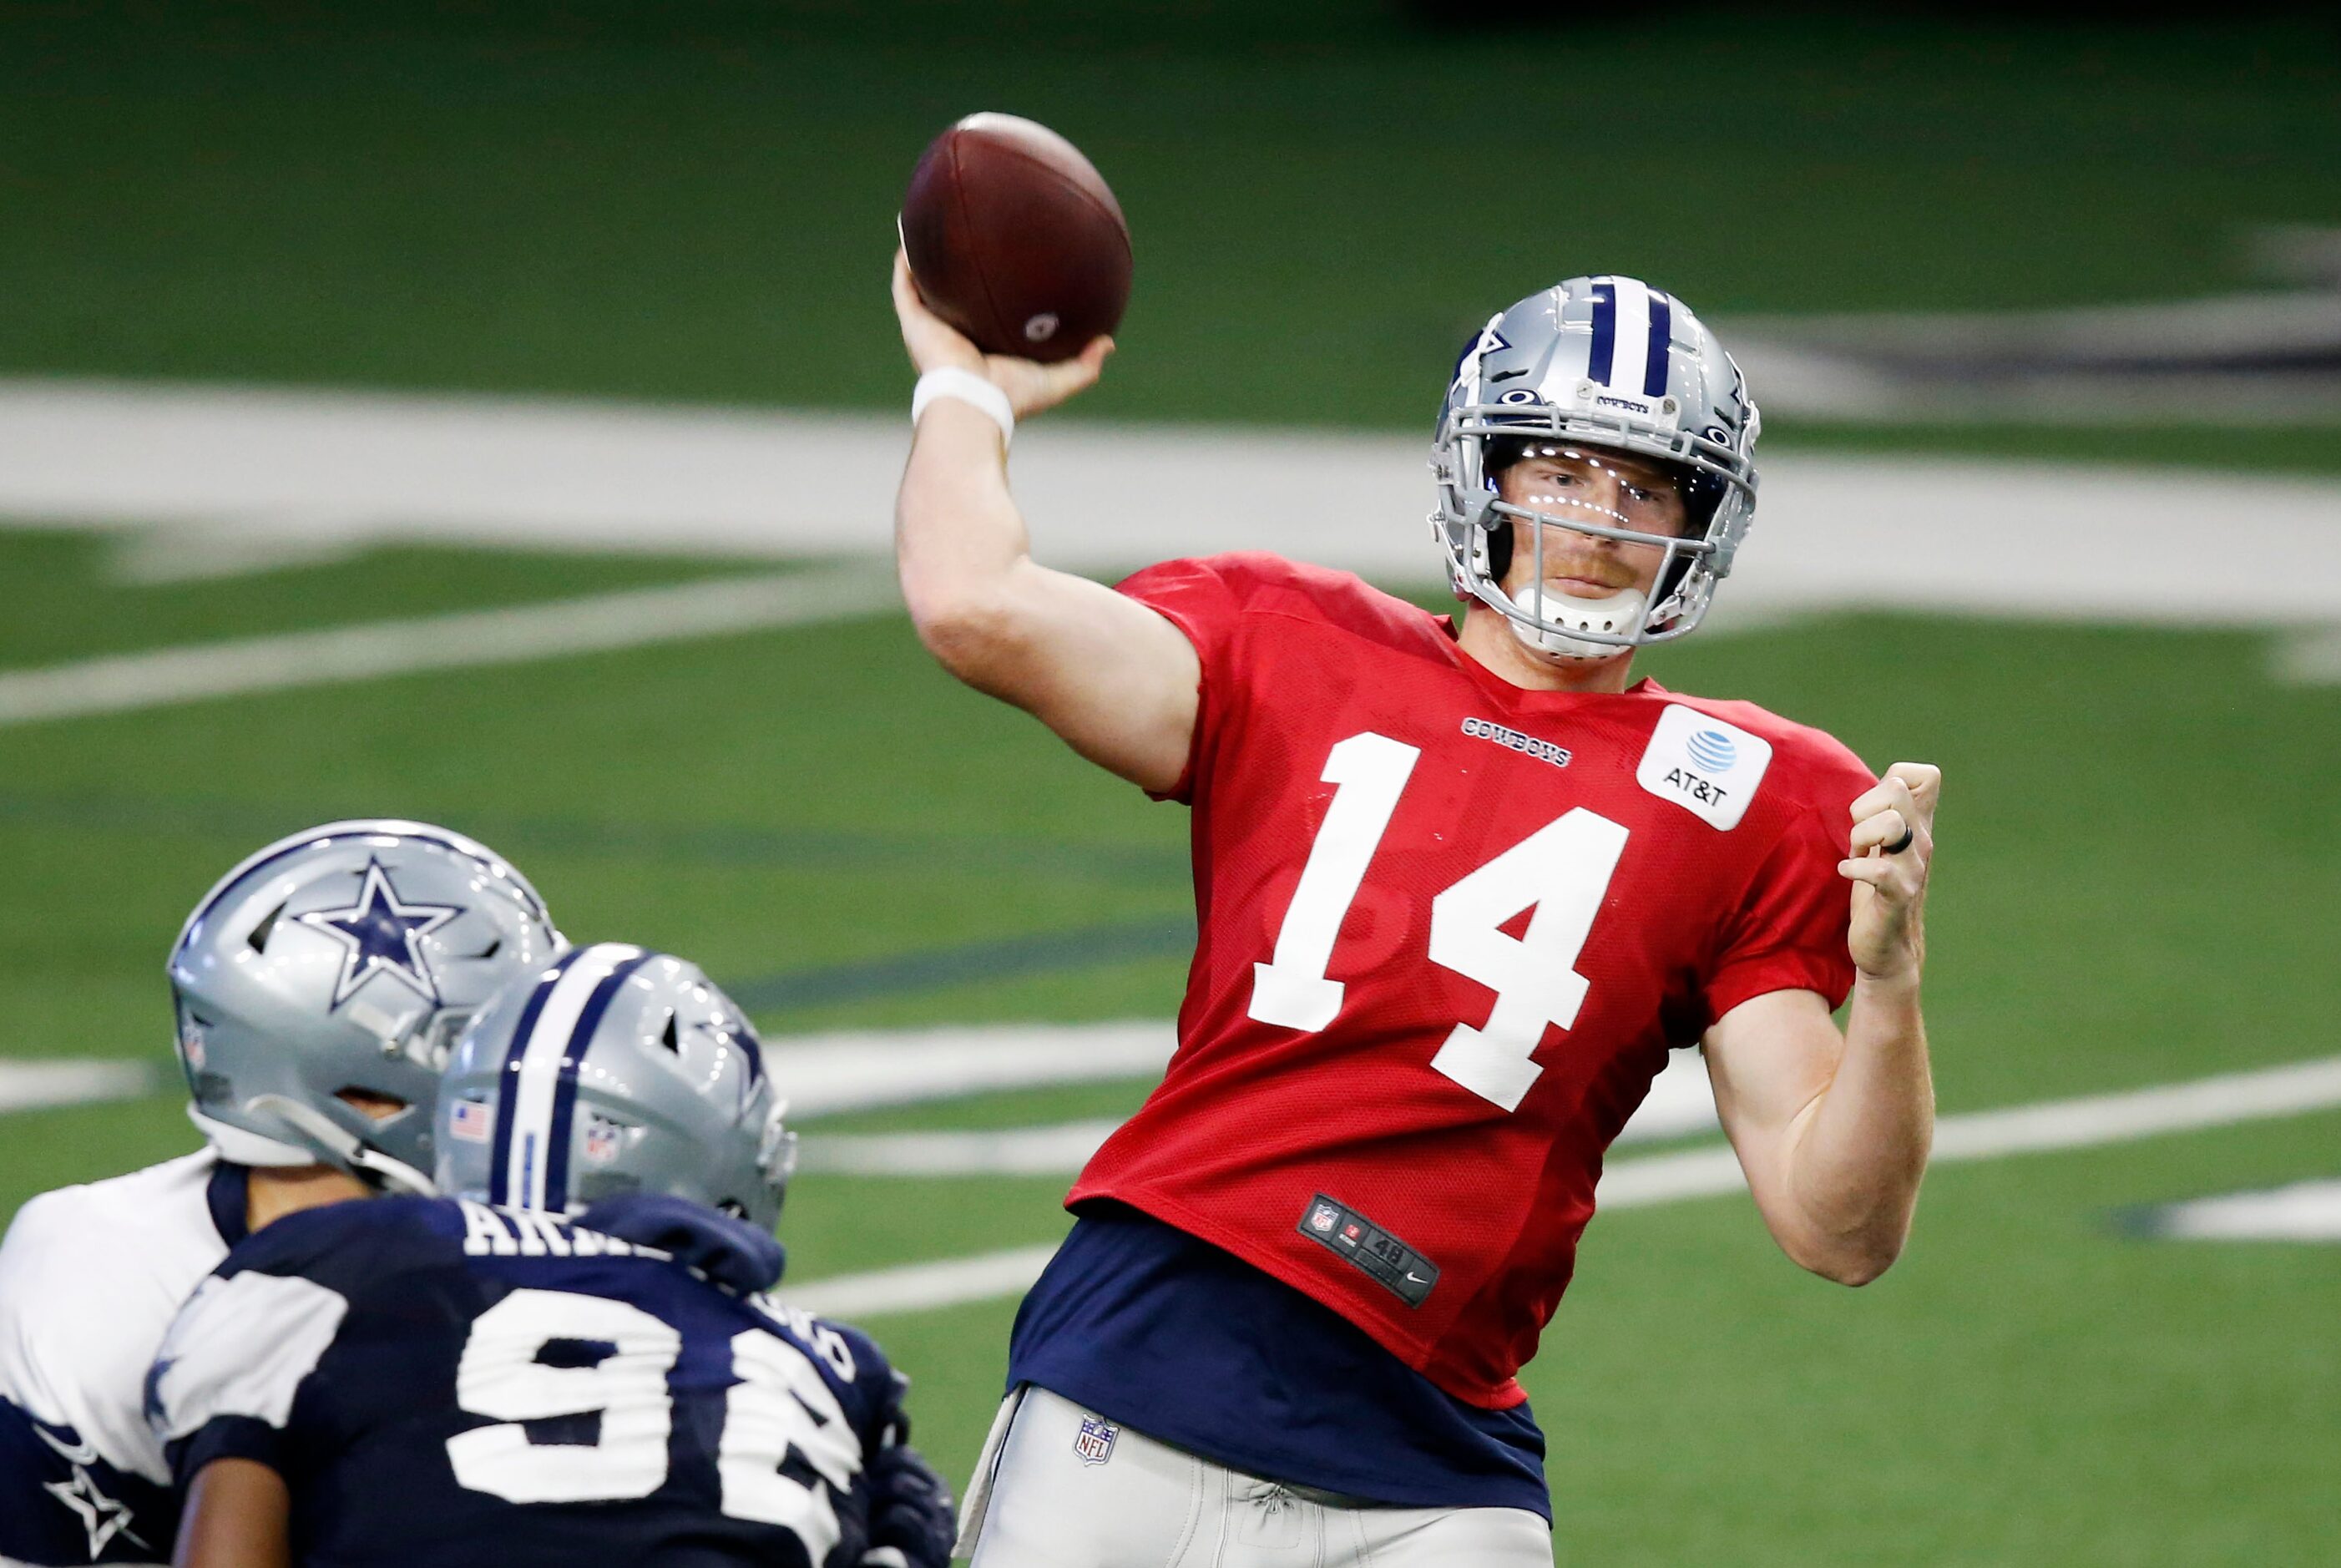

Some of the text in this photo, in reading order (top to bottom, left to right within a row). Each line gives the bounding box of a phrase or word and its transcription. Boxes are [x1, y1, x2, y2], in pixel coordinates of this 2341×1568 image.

[1596, 396, 1650, 414] COWBOYS
[1461, 717, 1573, 767] COWBOYS
[1662, 766, 1728, 807] AT&T
[1246, 731, 1631, 1114] 14
[1078, 1434, 1105, 1459] NFL
